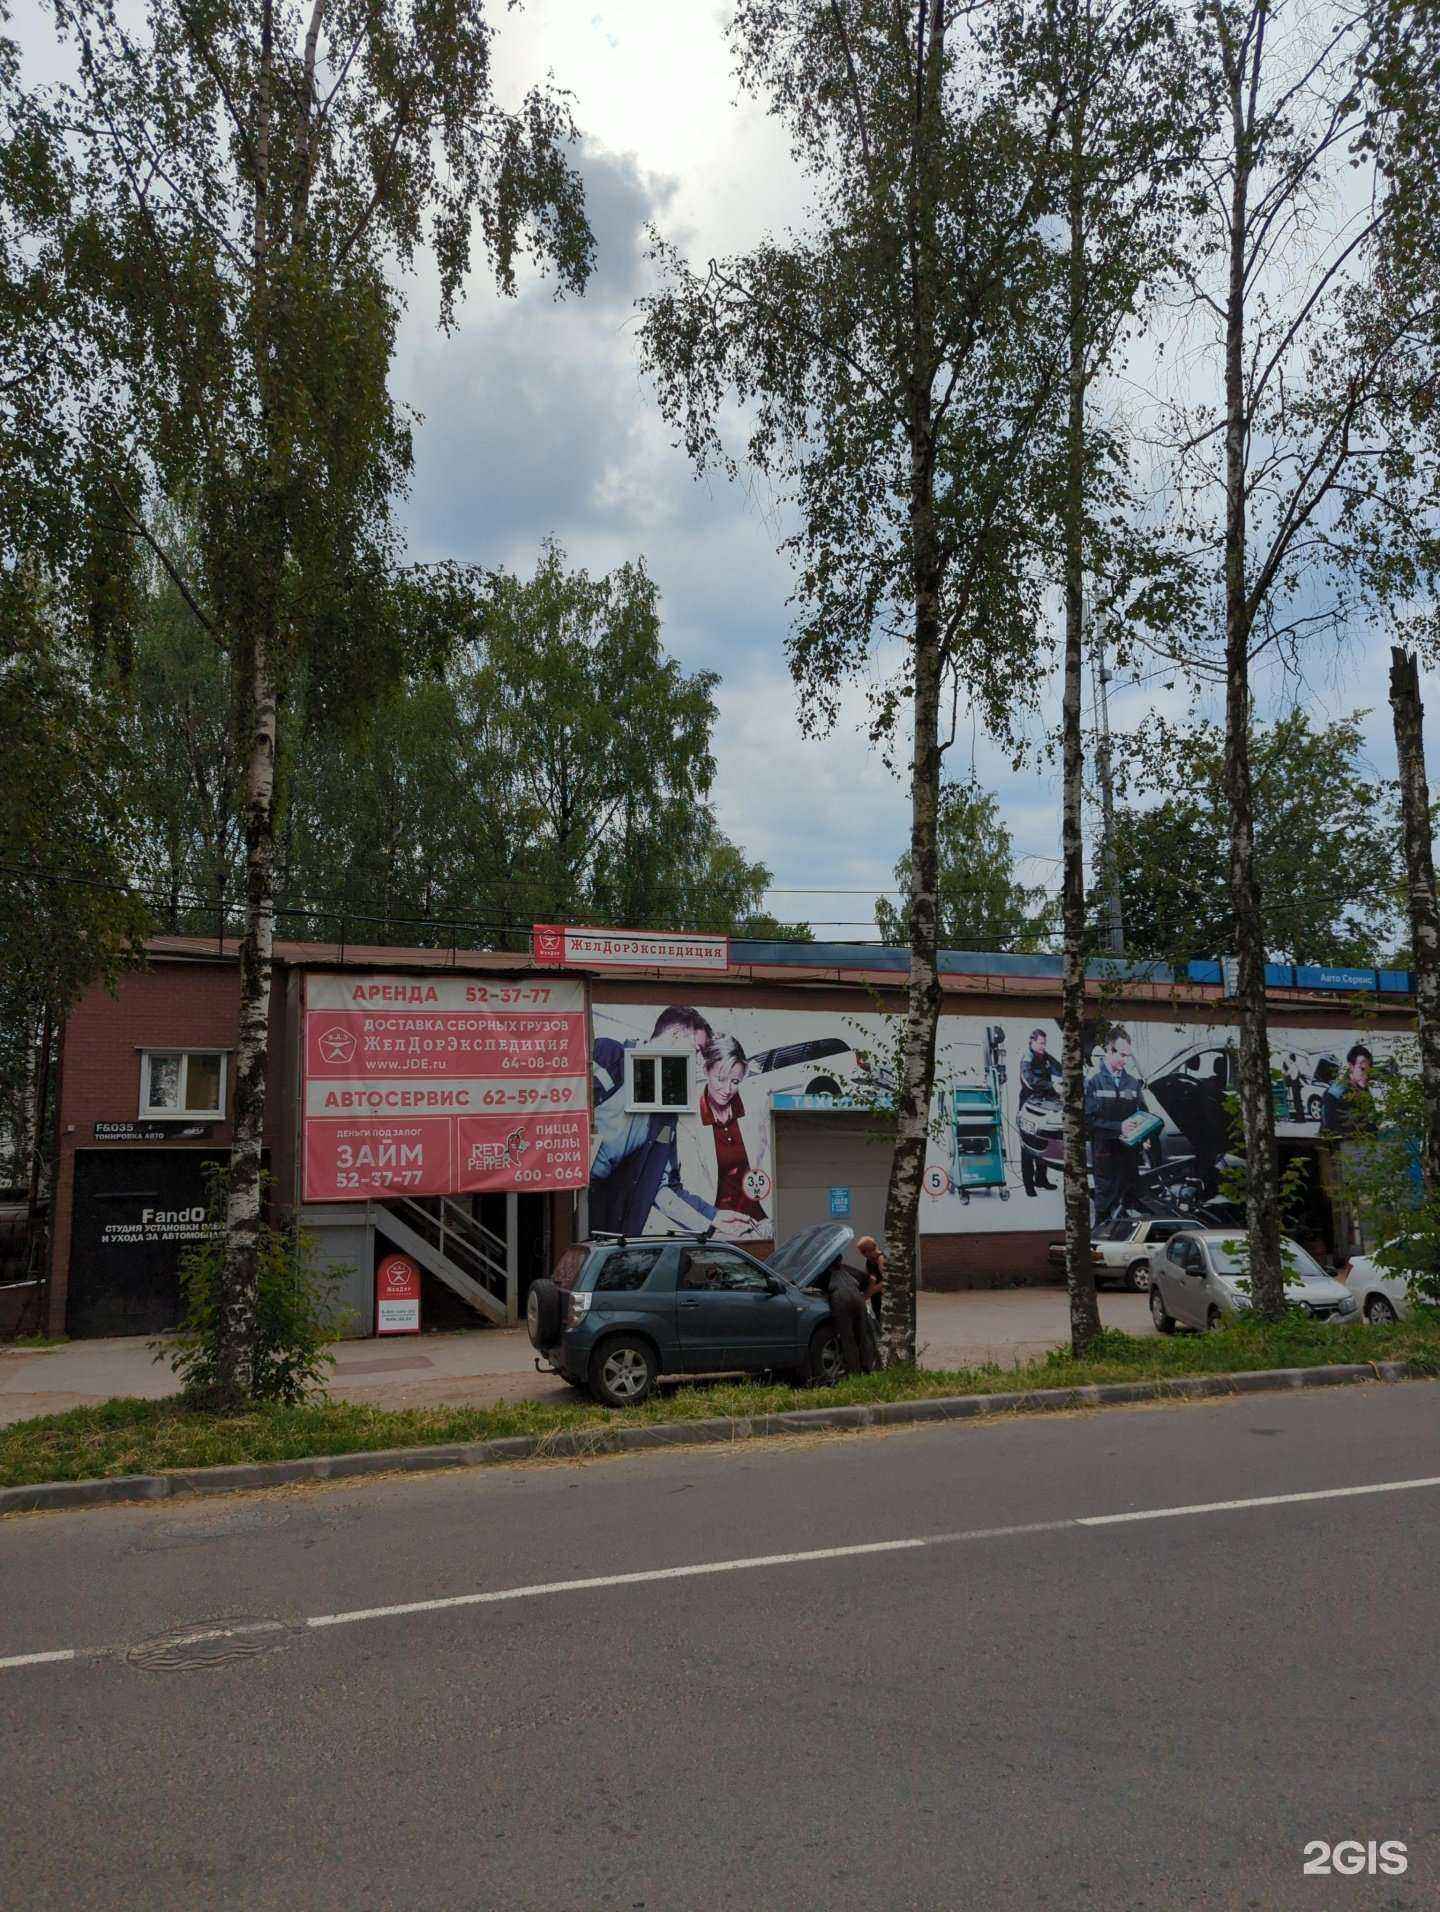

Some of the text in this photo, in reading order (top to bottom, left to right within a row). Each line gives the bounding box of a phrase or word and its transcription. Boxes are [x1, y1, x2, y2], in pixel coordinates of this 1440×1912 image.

[1320, 973, 1341, 984] Авто
[352, 985, 551, 1004] АРЕНДА 52-37-77
[364, 1019, 569, 1032] ДОСТАВКА СБОРНЫХ ГРУЗОВ
[366, 1056, 569, 1070] www.JDE.ru 64-08-08
[325, 1087, 573, 1108] АВТОСЕРВИС 62-59-89
[336, 1128, 423, 1138] ДЕНЬГИ ПОД ЗАЛОГ
[536, 1123, 579, 1135] ПИЦЦА
[95, 1132, 165, 1140] ТОНИРОВКА АВТО
[472, 1143, 505, 1158] RED
[535, 1138, 580, 1151] РОЛЛЫ
[336, 1138, 423, 1169] ЗАЙМ
[546, 1151, 581, 1164] ВОКИ
[336, 1170, 423, 1188] 52-37-77
[747, 1175, 765, 1188] 3,5
[931, 1174, 940, 1187] 5
[142, 1207, 205, 1223] FandO
[105, 1224, 143, 1233] СТУДИЯ
[145, 1223, 199, 1232] УСТАНОВКИ
[101, 1235, 109, 1243] И
[111, 1234, 144, 1242] УХОДА
